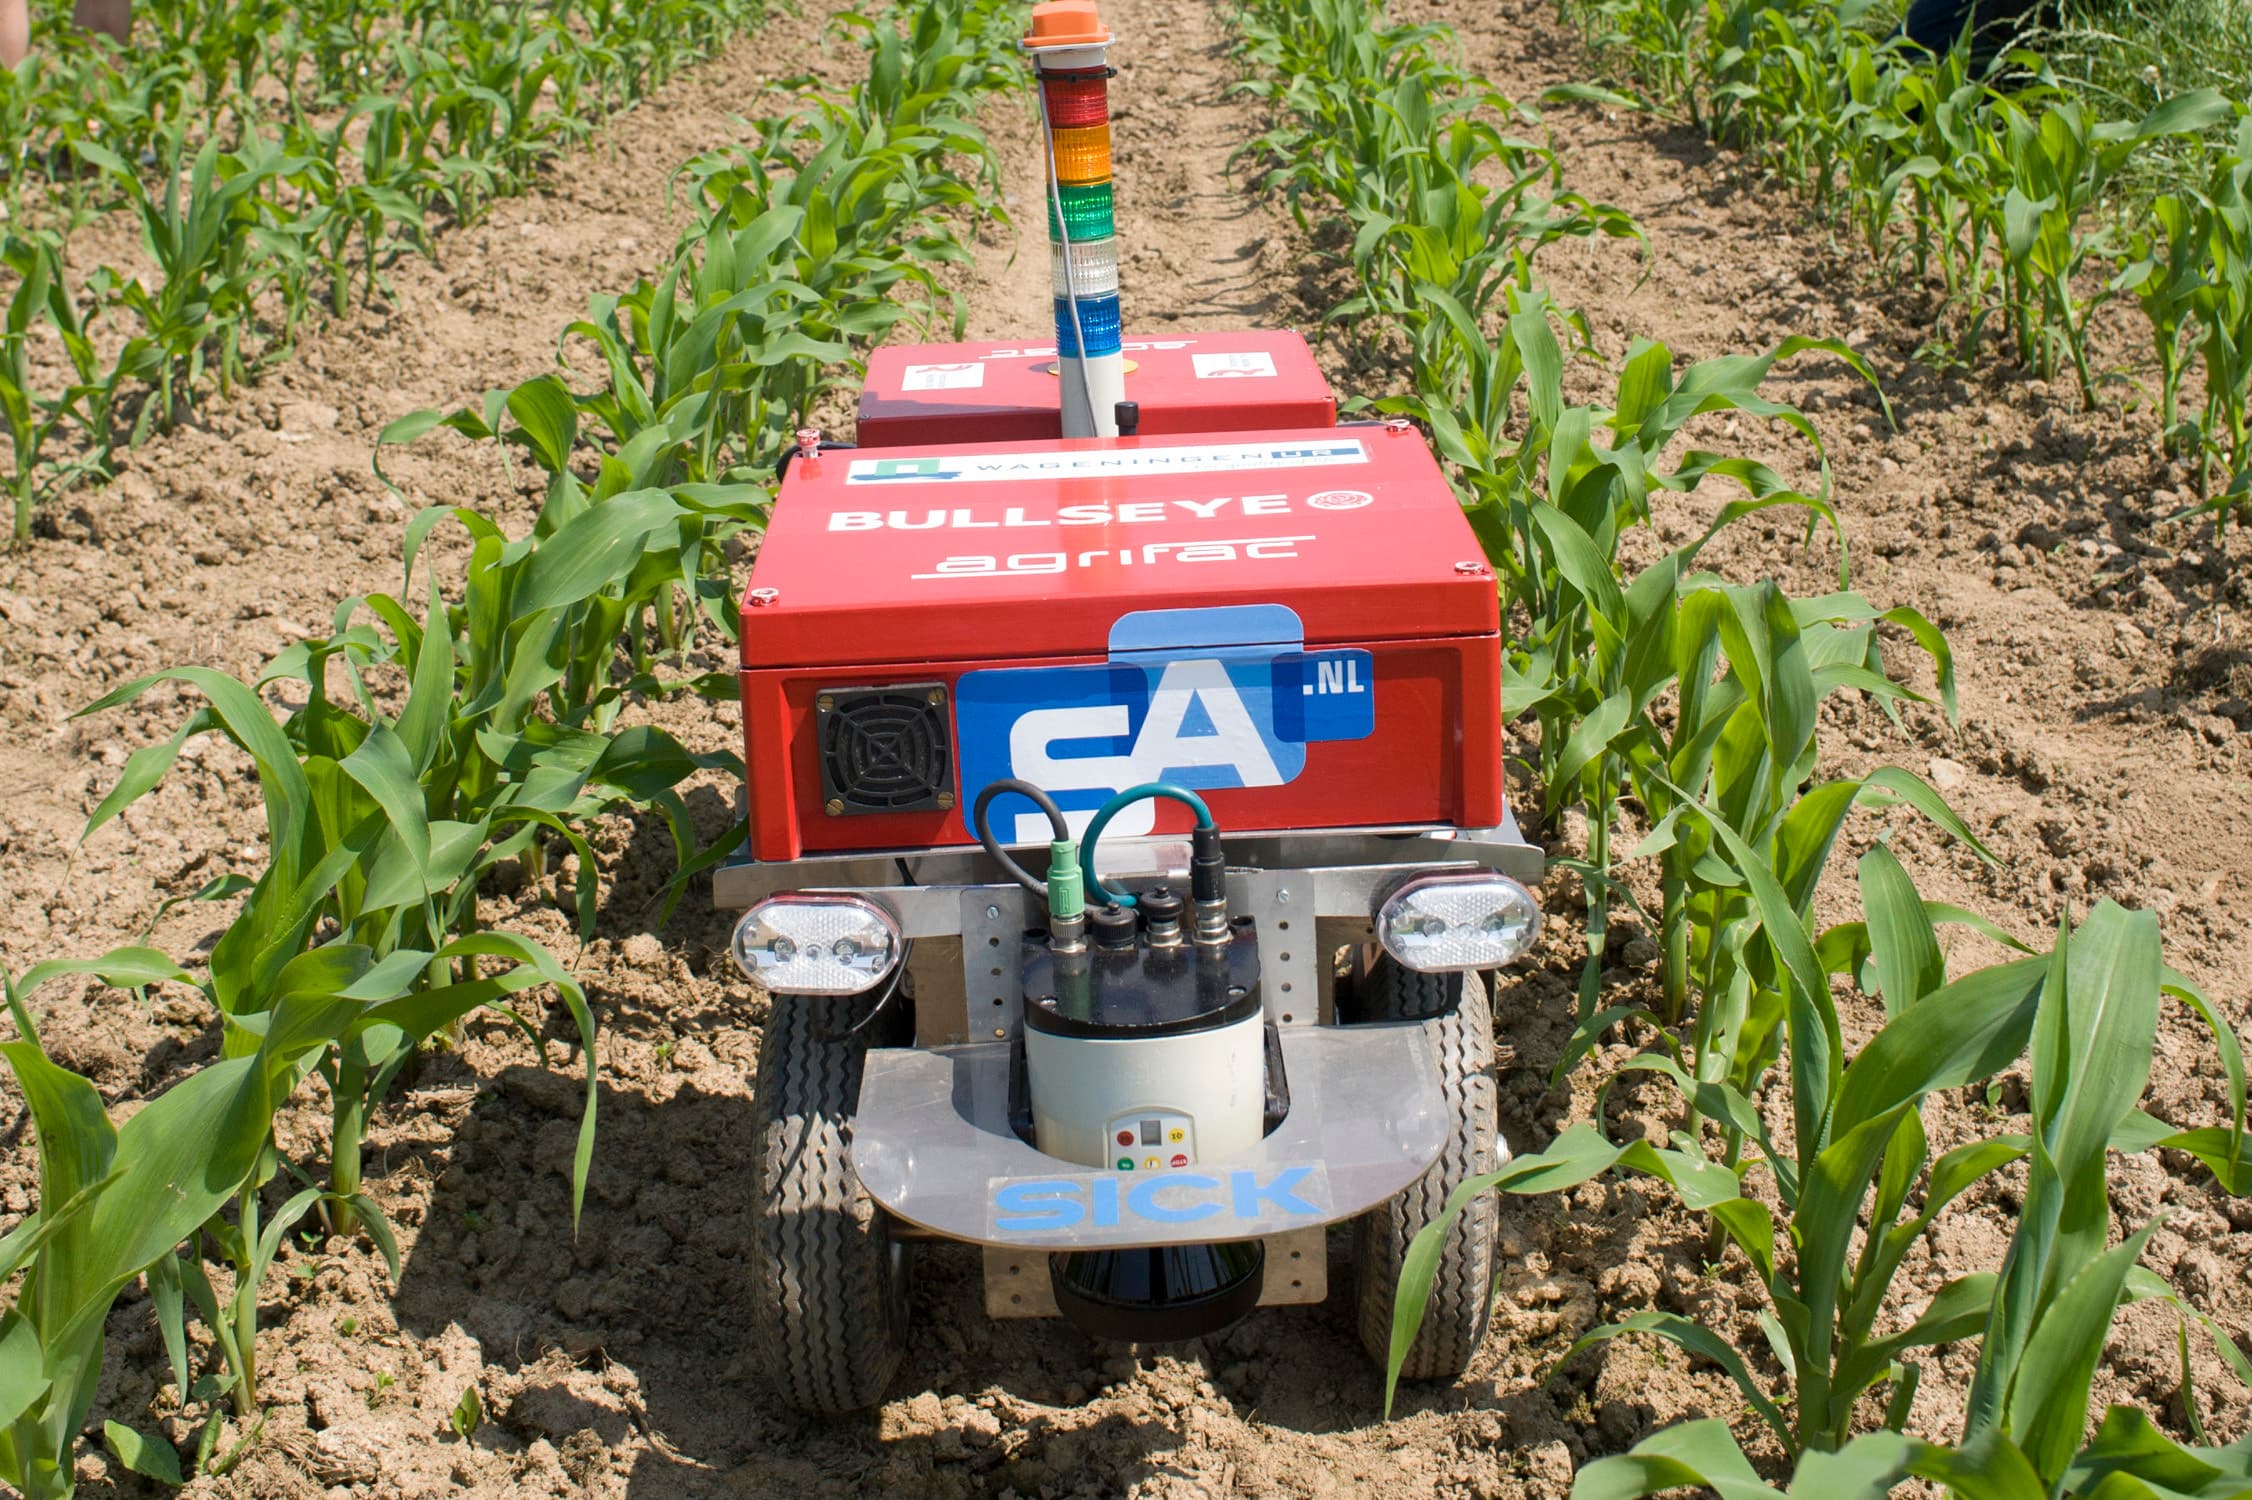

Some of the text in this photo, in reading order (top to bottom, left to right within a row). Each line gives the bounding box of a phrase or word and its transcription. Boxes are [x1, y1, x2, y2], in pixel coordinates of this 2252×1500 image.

[976, 453, 1263, 471] WAGENINGEN
[1280, 449, 1333, 458] UR
[827, 493, 1292, 532] BULLSEYE
[911, 535, 1316, 579] agrifac
[994, 1166, 1325, 1230] SICK
